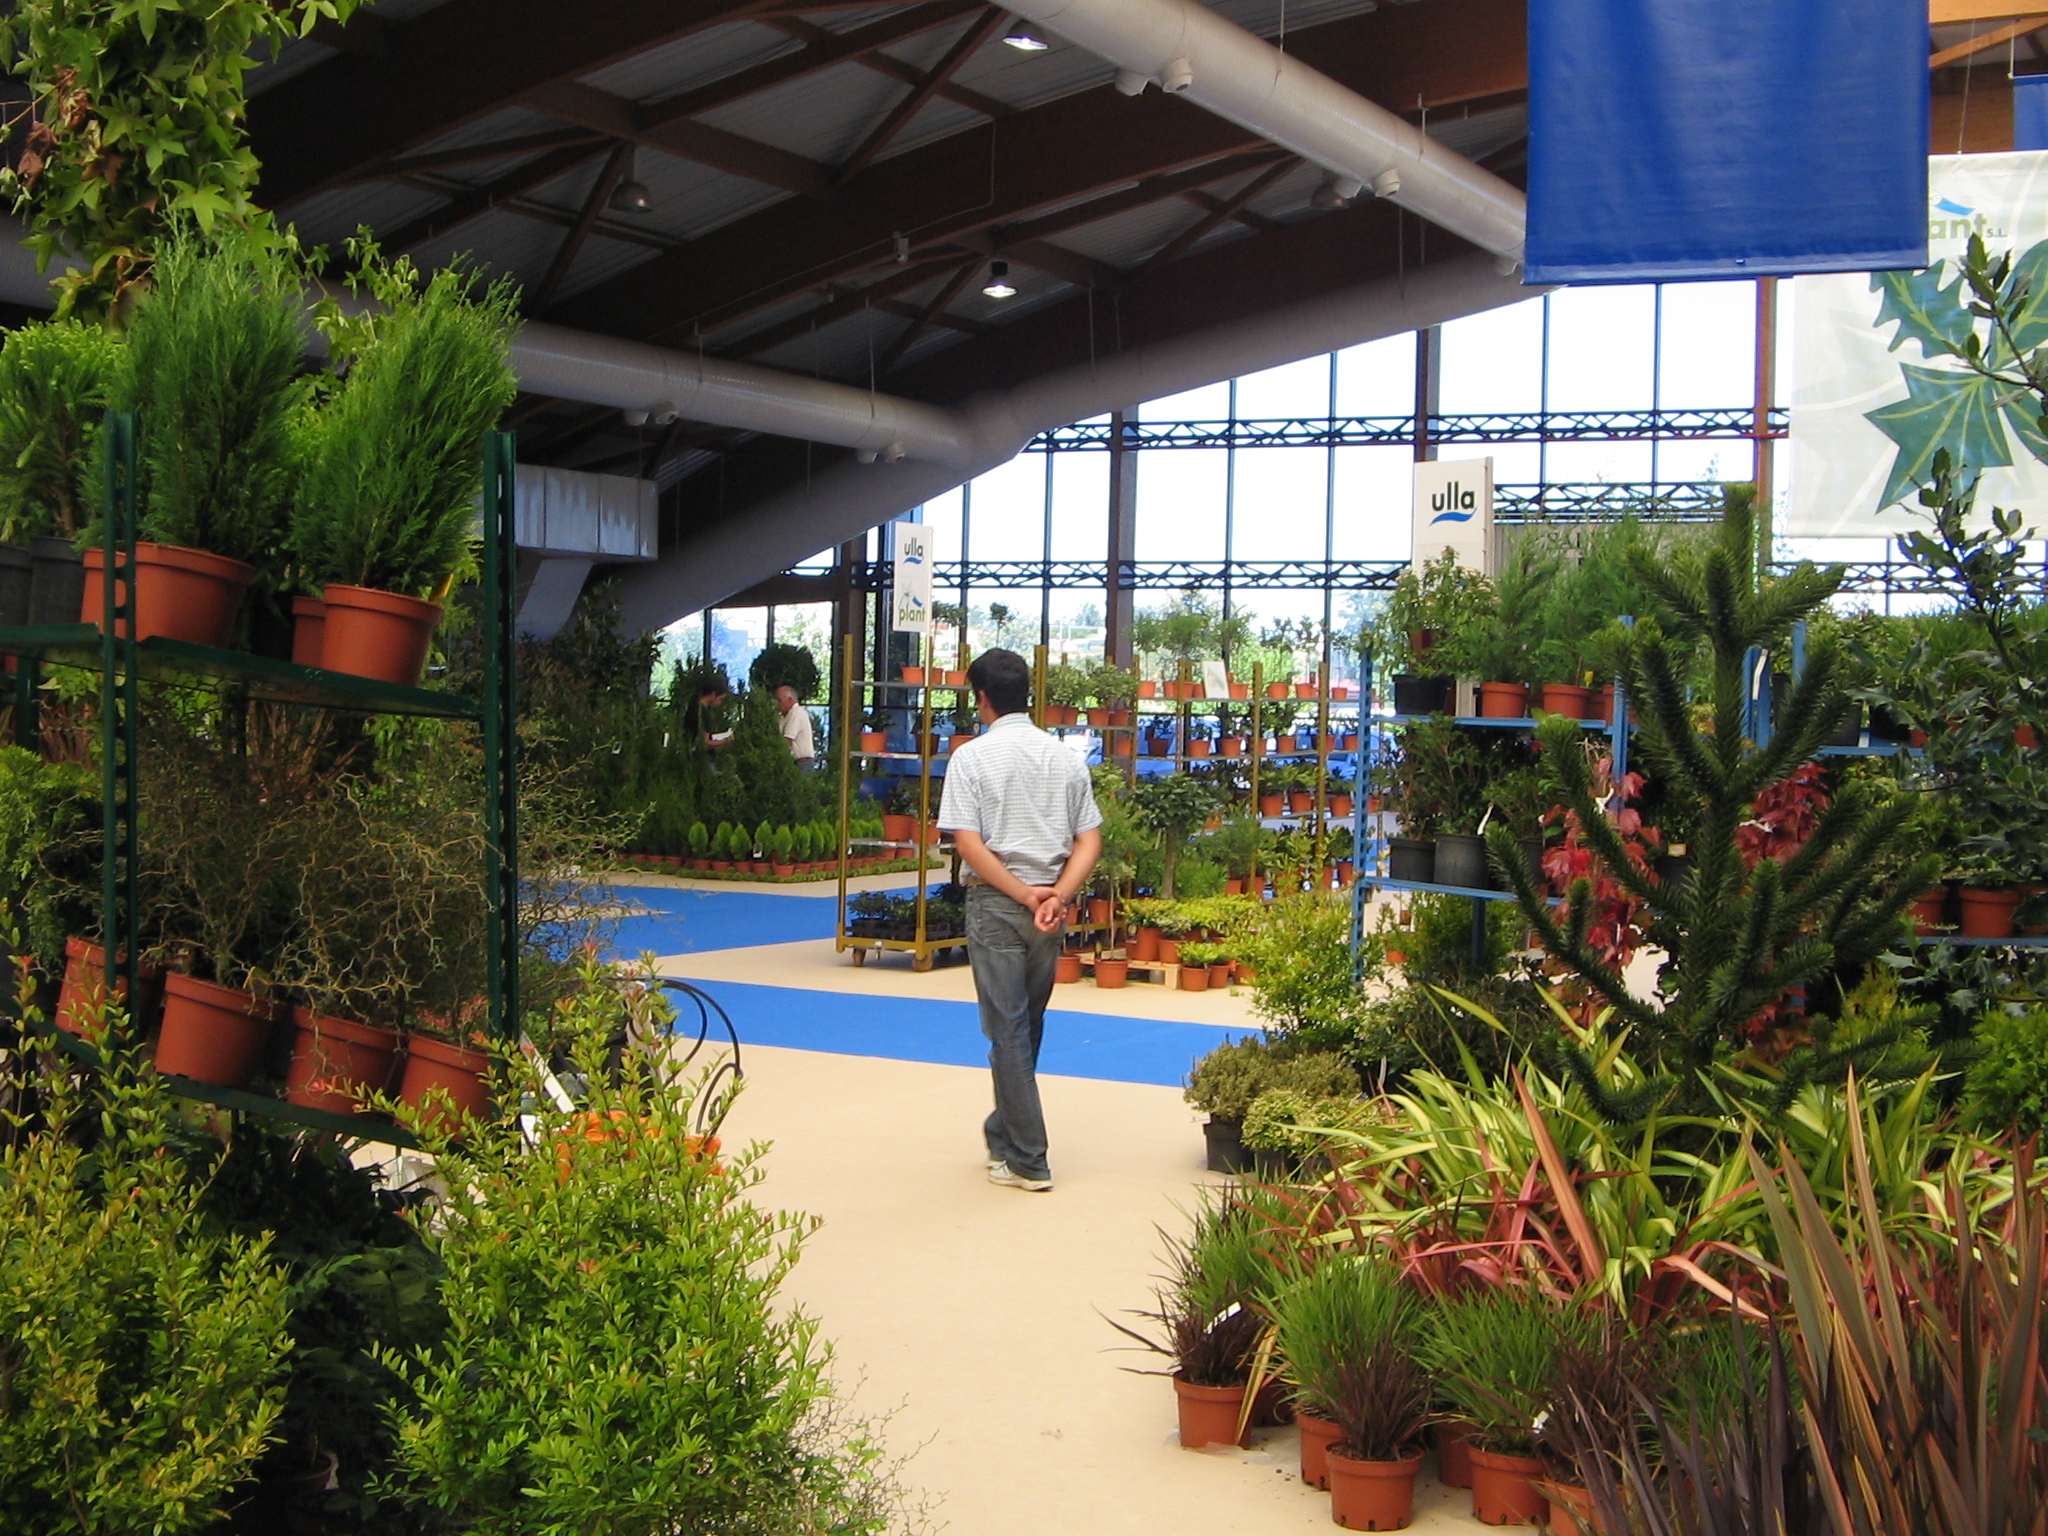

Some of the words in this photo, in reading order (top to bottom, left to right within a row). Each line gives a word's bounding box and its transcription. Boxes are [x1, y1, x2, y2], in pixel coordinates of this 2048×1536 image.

[1928, 212, 1987, 240] ant
[1431, 481, 1475, 511] ulla
[904, 537, 924, 556] ulla
[898, 604, 926, 627] plant
